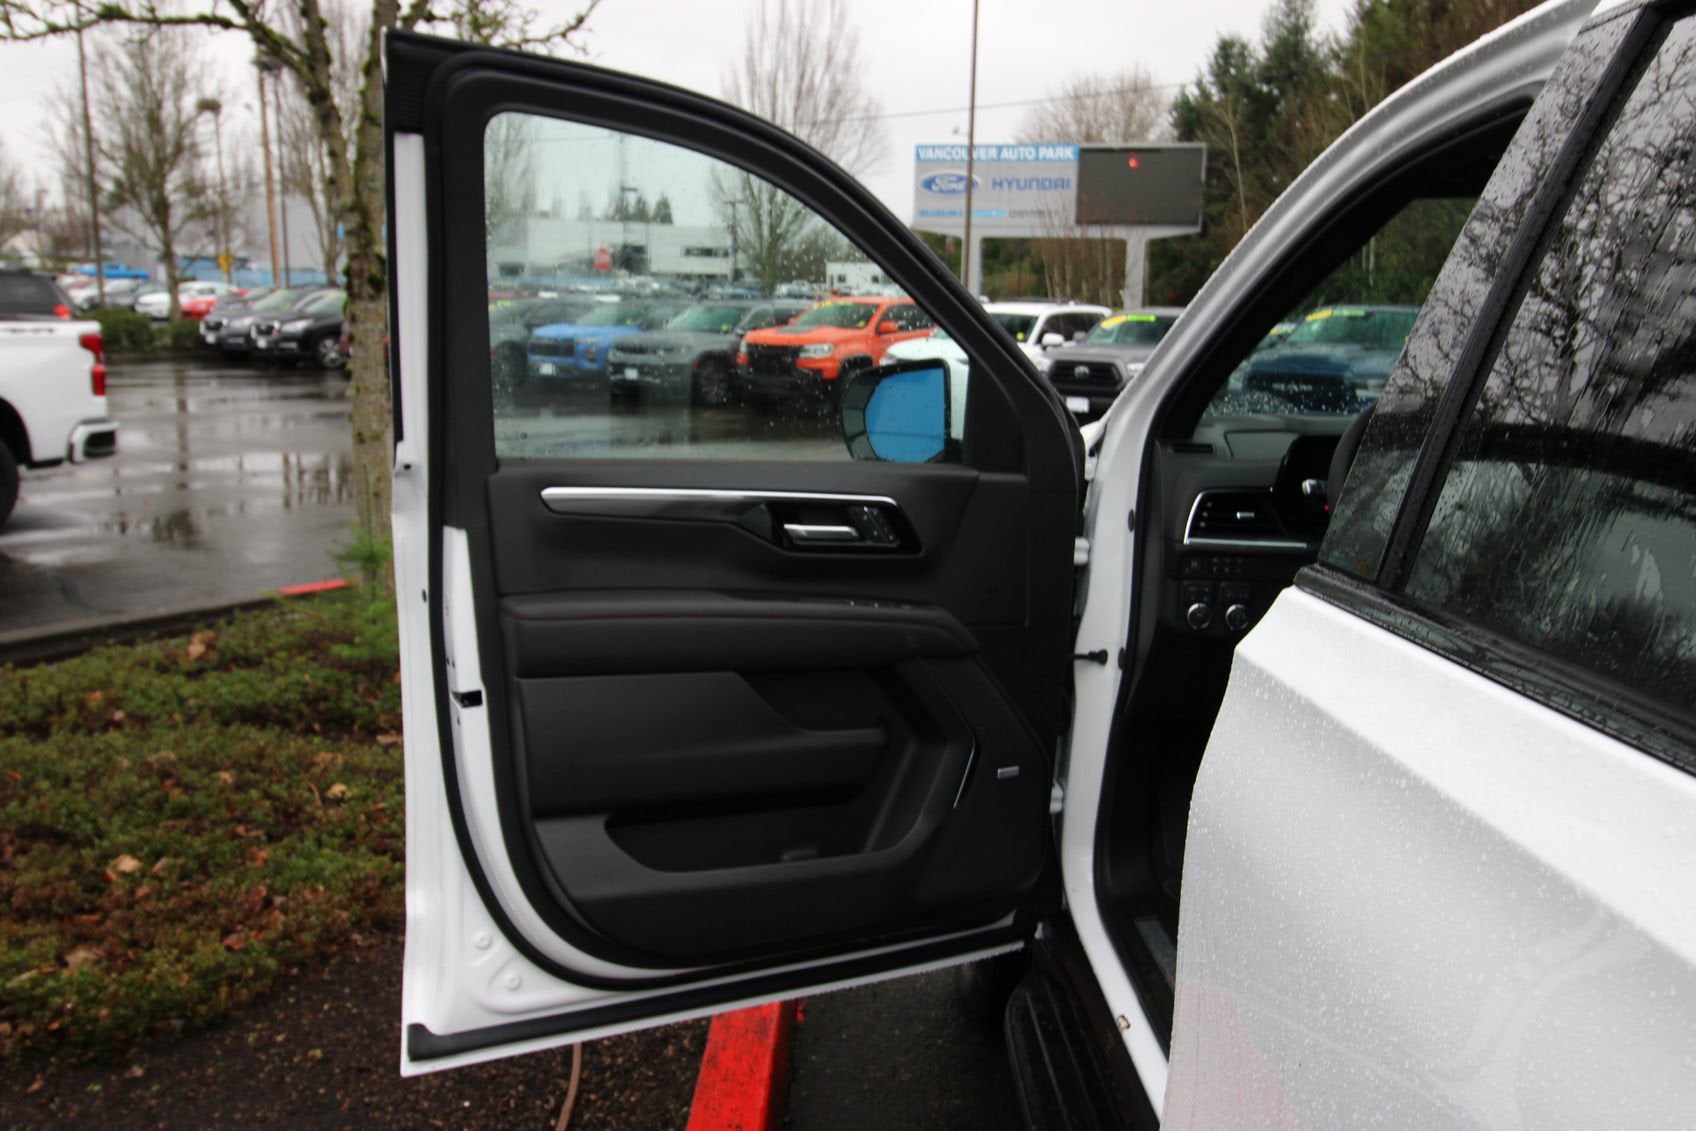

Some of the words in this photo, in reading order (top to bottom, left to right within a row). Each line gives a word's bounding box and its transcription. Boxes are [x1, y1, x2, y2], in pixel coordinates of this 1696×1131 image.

[1000, 147, 1035, 160] AUTO
[1038, 147, 1074, 160] PARK
[930, 175, 966, 191] Ford
[991, 177, 1071, 190] HYUNDAI
